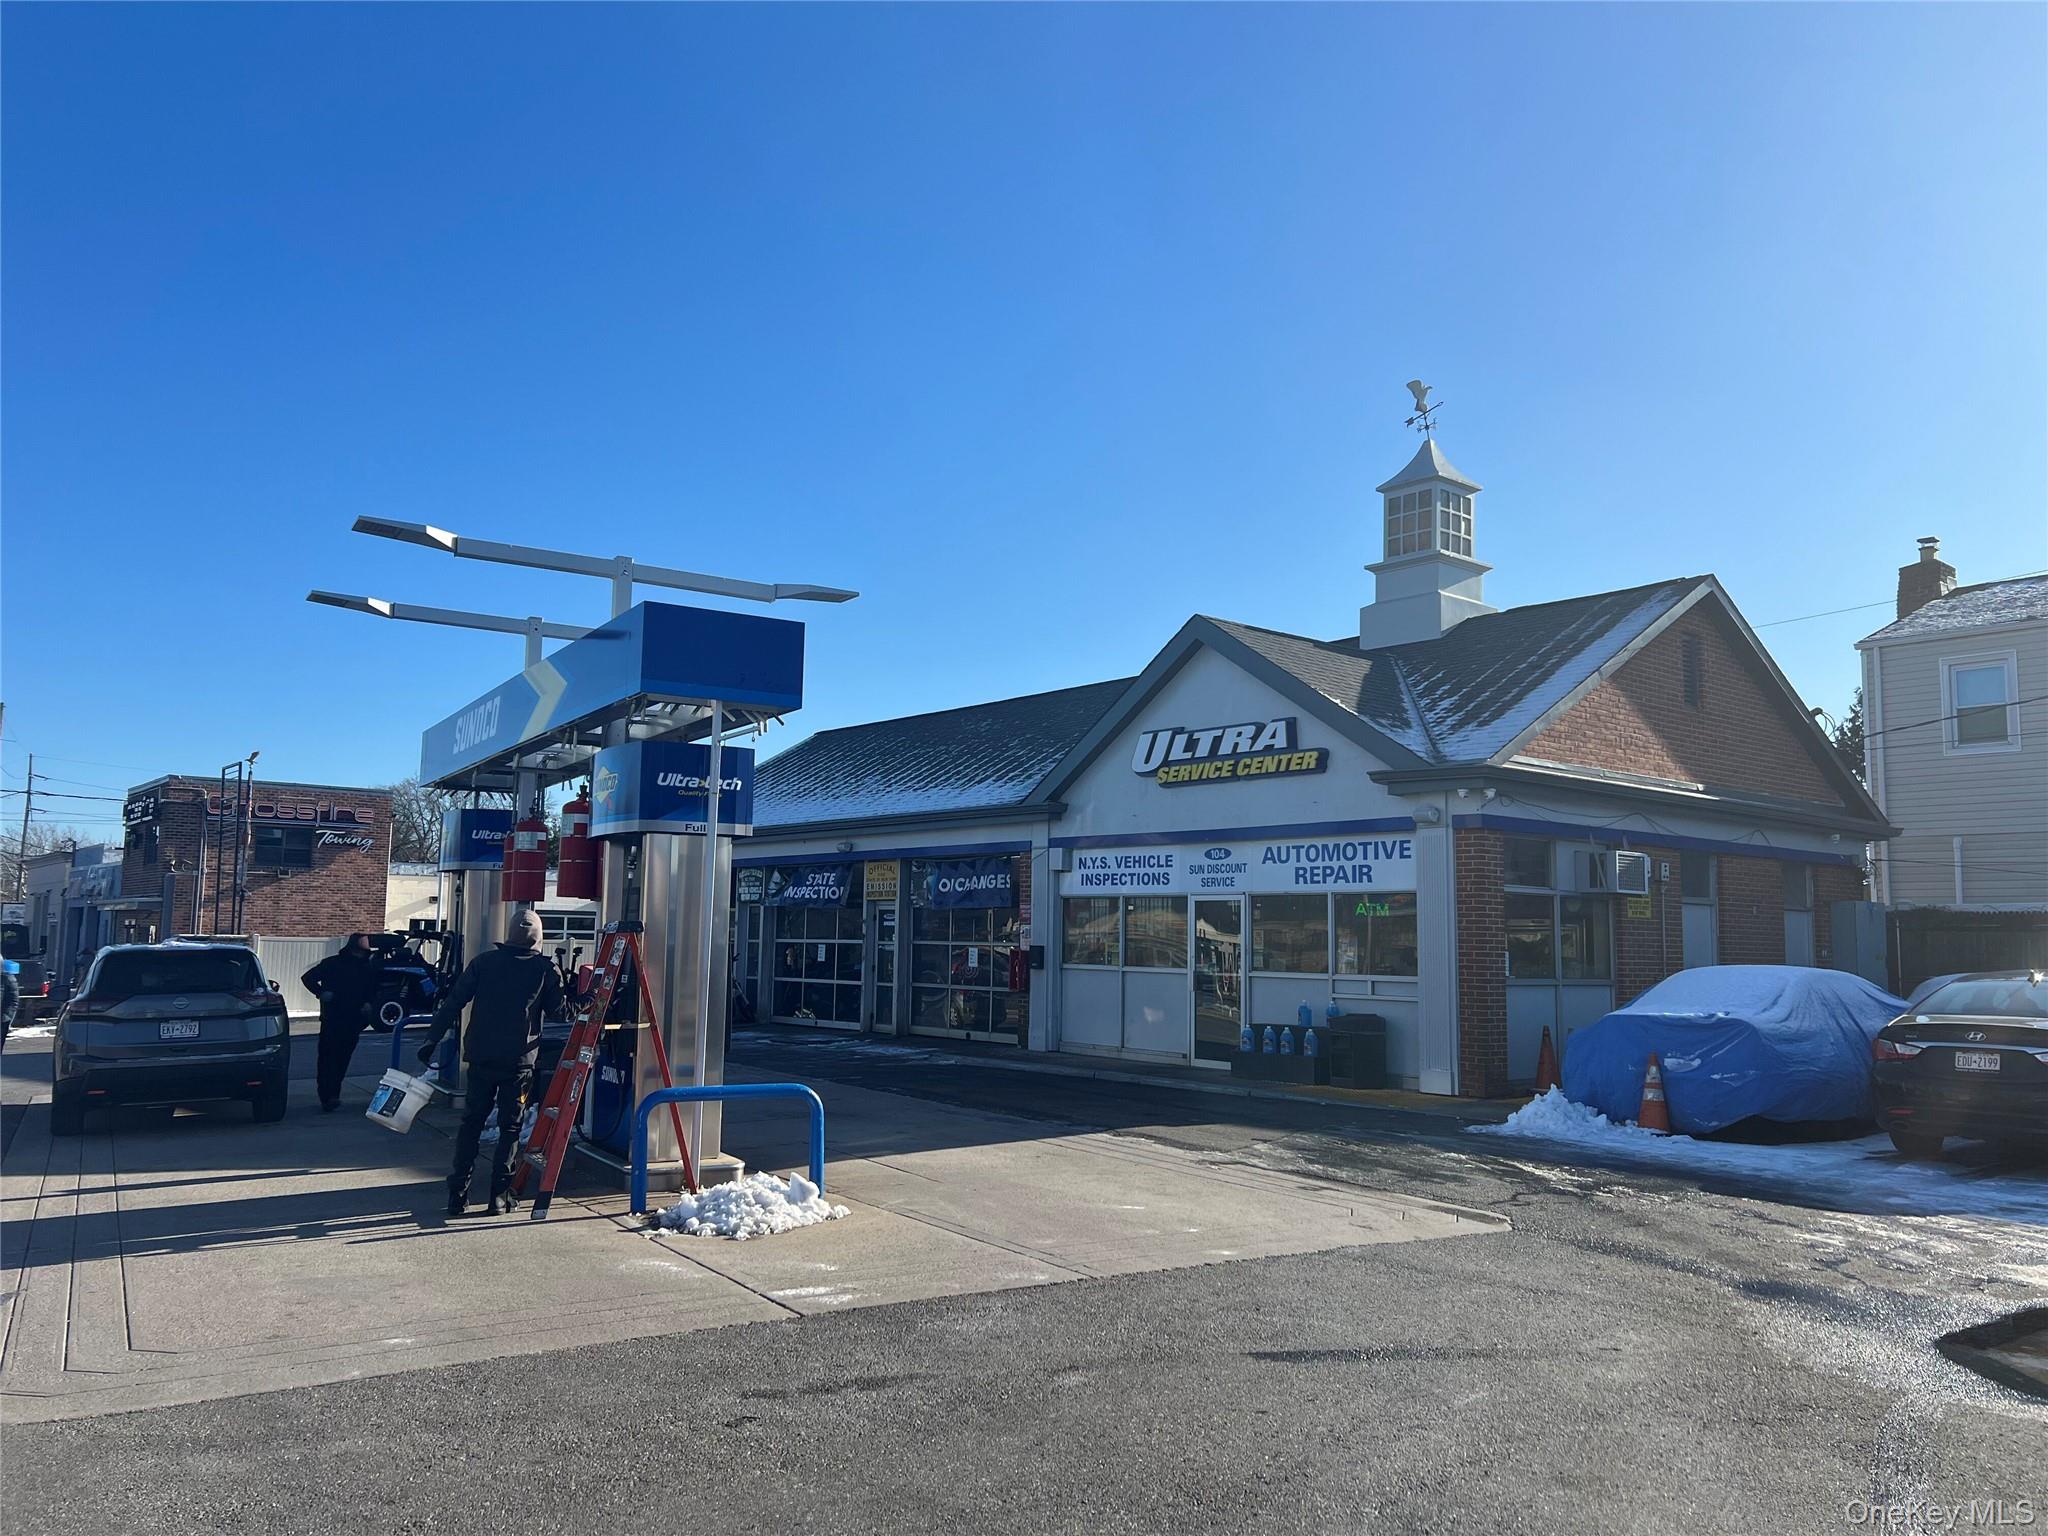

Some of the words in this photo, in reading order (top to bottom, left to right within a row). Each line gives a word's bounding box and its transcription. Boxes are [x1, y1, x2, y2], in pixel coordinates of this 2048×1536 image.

[453, 696, 500, 755] SUNOCO
[1131, 720, 1289, 773] ULTRA
[1156, 759, 1235, 784] SERVICE
[1236, 751, 1319, 776] CENTER
[684, 823, 706, 832] Full
[315, 829, 375, 853] Towing
[1210, 849, 1226, 859] 104
[1261, 839, 1412, 865] AUTOMOTIVE
[1078, 856, 1111, 870] N.Y.S.
[1114, 854, 1174, 869] VEHICLE
[1188, 864, 1205, 875] SUN
[1207, 863, 1248, 875] DISCOUNT
[806, 872, 836, 885] STATE
[1080, 872, 1170, 887] INSPECTIONS
[1200, 876, 1236, 888] SERVICE
[1294, 864, 1373, 885] REPAIR
[866, 881, 897, 890] EMISSION
[1355, 903, 1390, 917] ATM
